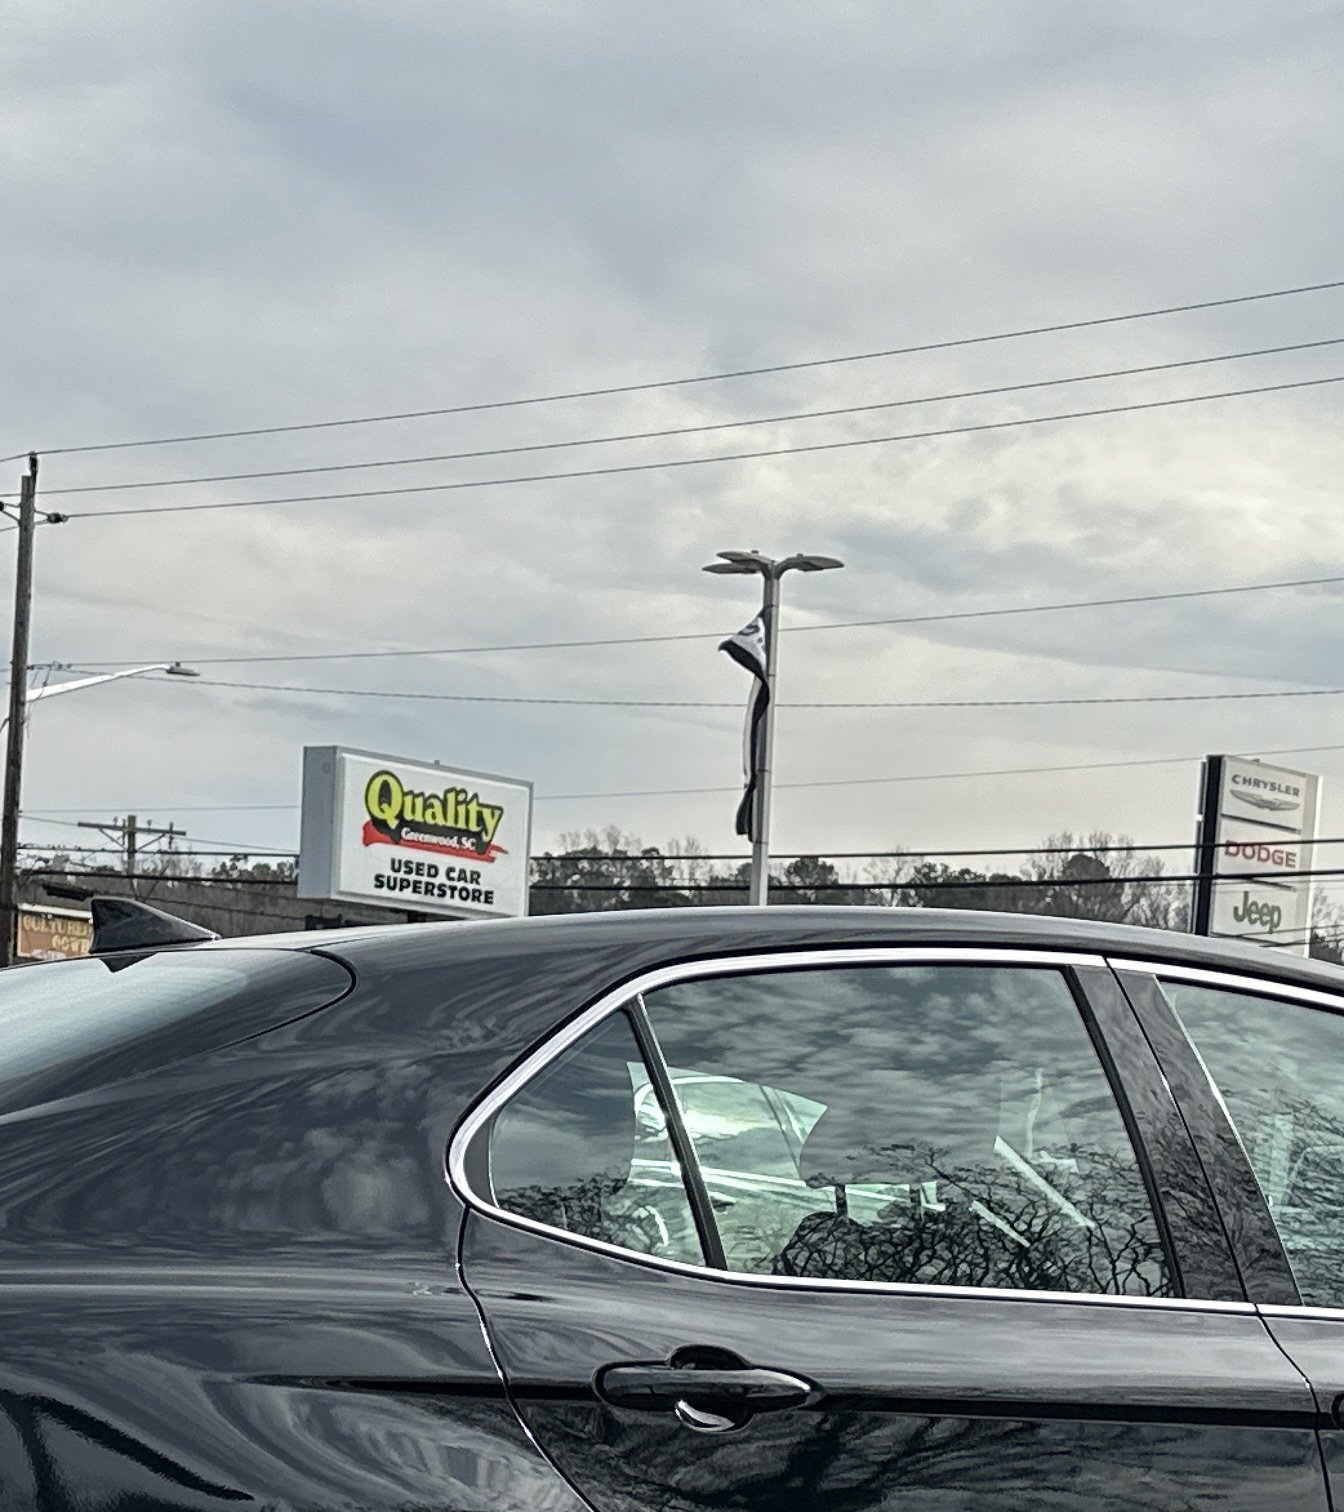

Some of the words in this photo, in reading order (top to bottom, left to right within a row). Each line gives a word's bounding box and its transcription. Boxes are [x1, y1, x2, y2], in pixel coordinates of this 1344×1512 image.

[1231, 773, 1300, 797] CHRYSLER
[366, 771, 503, 842] Quality
[1224, 840, 1297, 868] DODGE
[391, 858, 439, 879] USED
[446, 867, 481, 885] CAR
[374, 874, 494, 905] SUPERSTORE
[1233, 891, 1282, 934] Jeep
